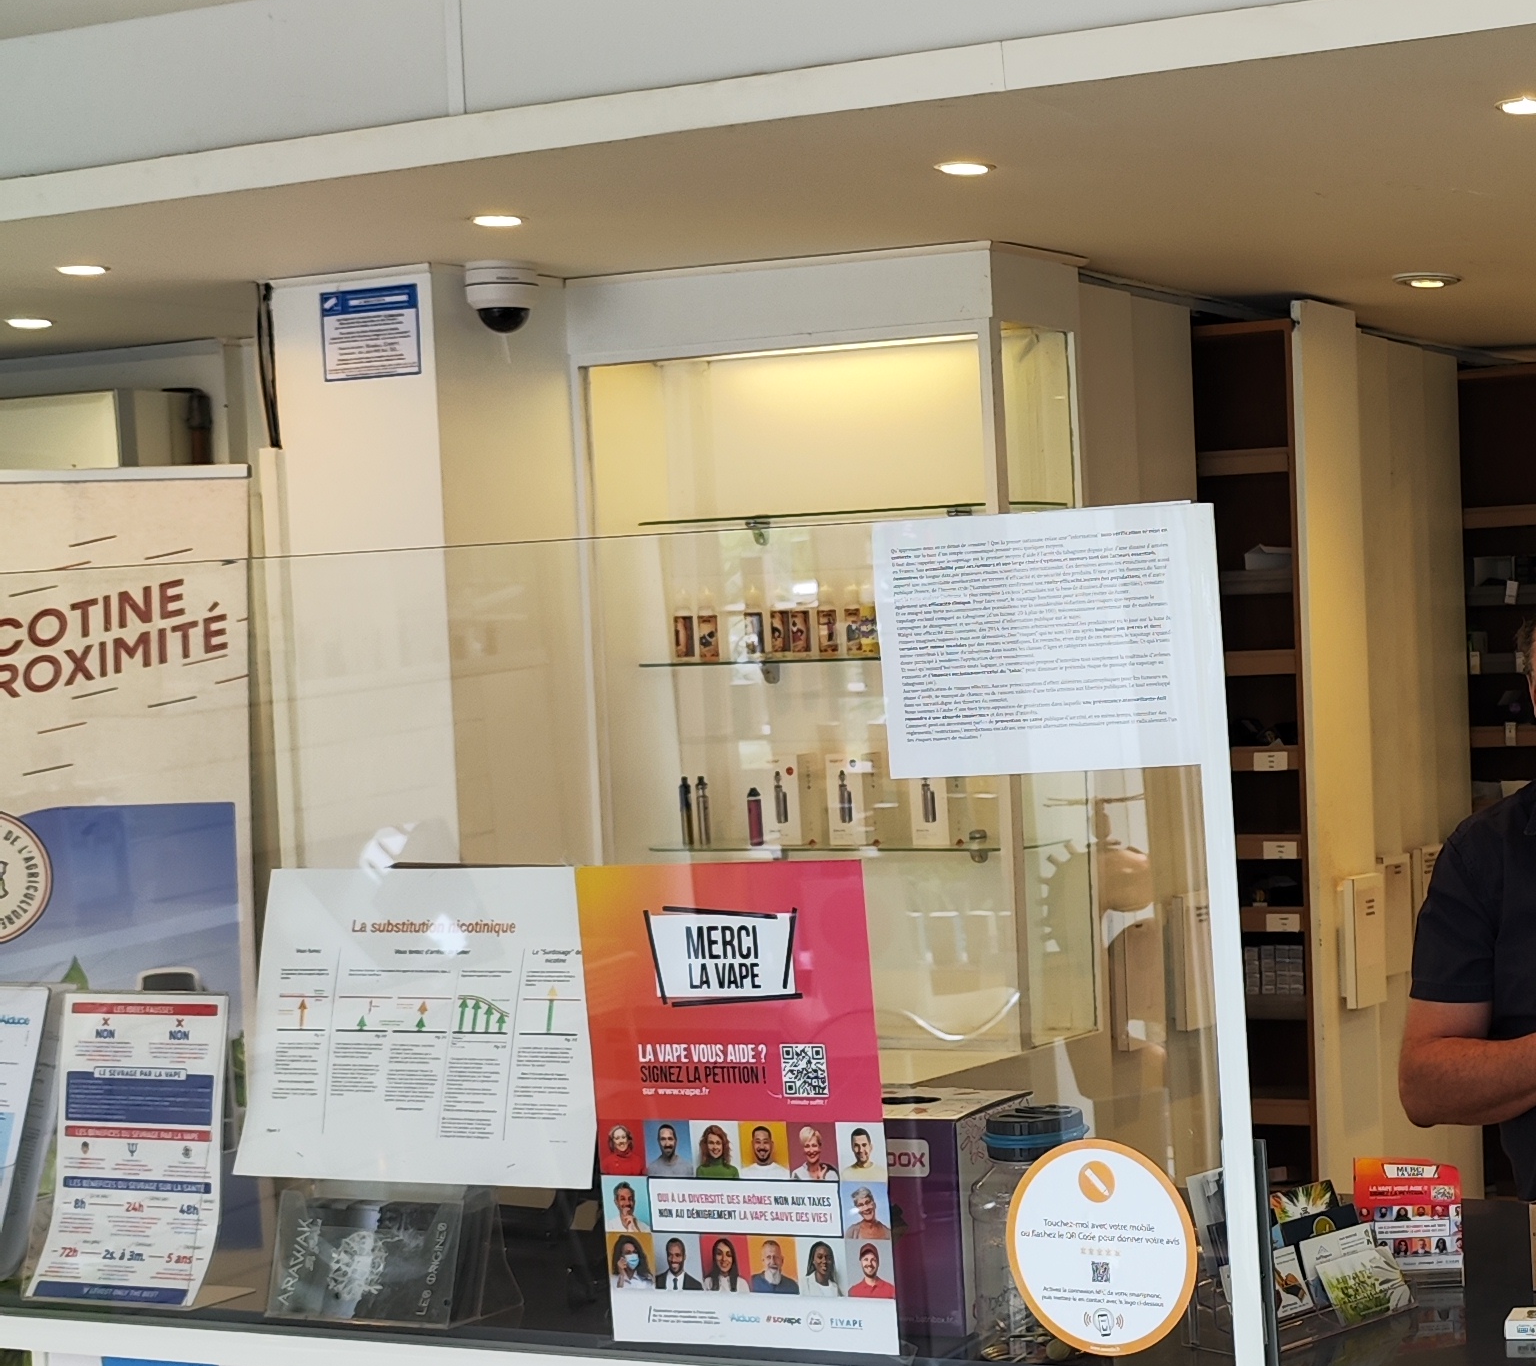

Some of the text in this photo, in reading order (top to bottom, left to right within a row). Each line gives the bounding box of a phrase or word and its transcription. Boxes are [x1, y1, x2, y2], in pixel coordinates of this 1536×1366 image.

[352, 919, 367, 933] La
[685, 925, 759, 960] MERCI
[688, 962, 762, 989] LA VAPE
[638, 1044, 767, 1063] LA VAPE VOUS AIDE ?
[640, 1062, 767, 1084] SIGNEZ LA PÉTITION !
[677, 1193, 687, 1203] LA
[727, 1194, 741, 1205] DES
[774, 1196, 789, 1206] NON
[791, 1196, 806, 1206] AUX
[807, 1196, 832, 1207] TAXES
[738, 1210, 748, 1220] LA
[749, 1210, 769, 1221] VAPE
[770, 1211, 794, 1222] SAUVE
[795, 1211, 810, 1222] DES
[1109, 1223, 1128, 1231] votre
[1129, 1223, 1155, 1232] mobile
[1078, 1232, 1096, 1241] Code
[1098, 1234, 1115, 1243] pour
[1117, 1235, 1144, 1244] donner
[1145, 1237, 1164, 1245] votre
[1165, 1237, 1180, 1246] avis
[276, 1218, 314, 1307] ARAWAK
